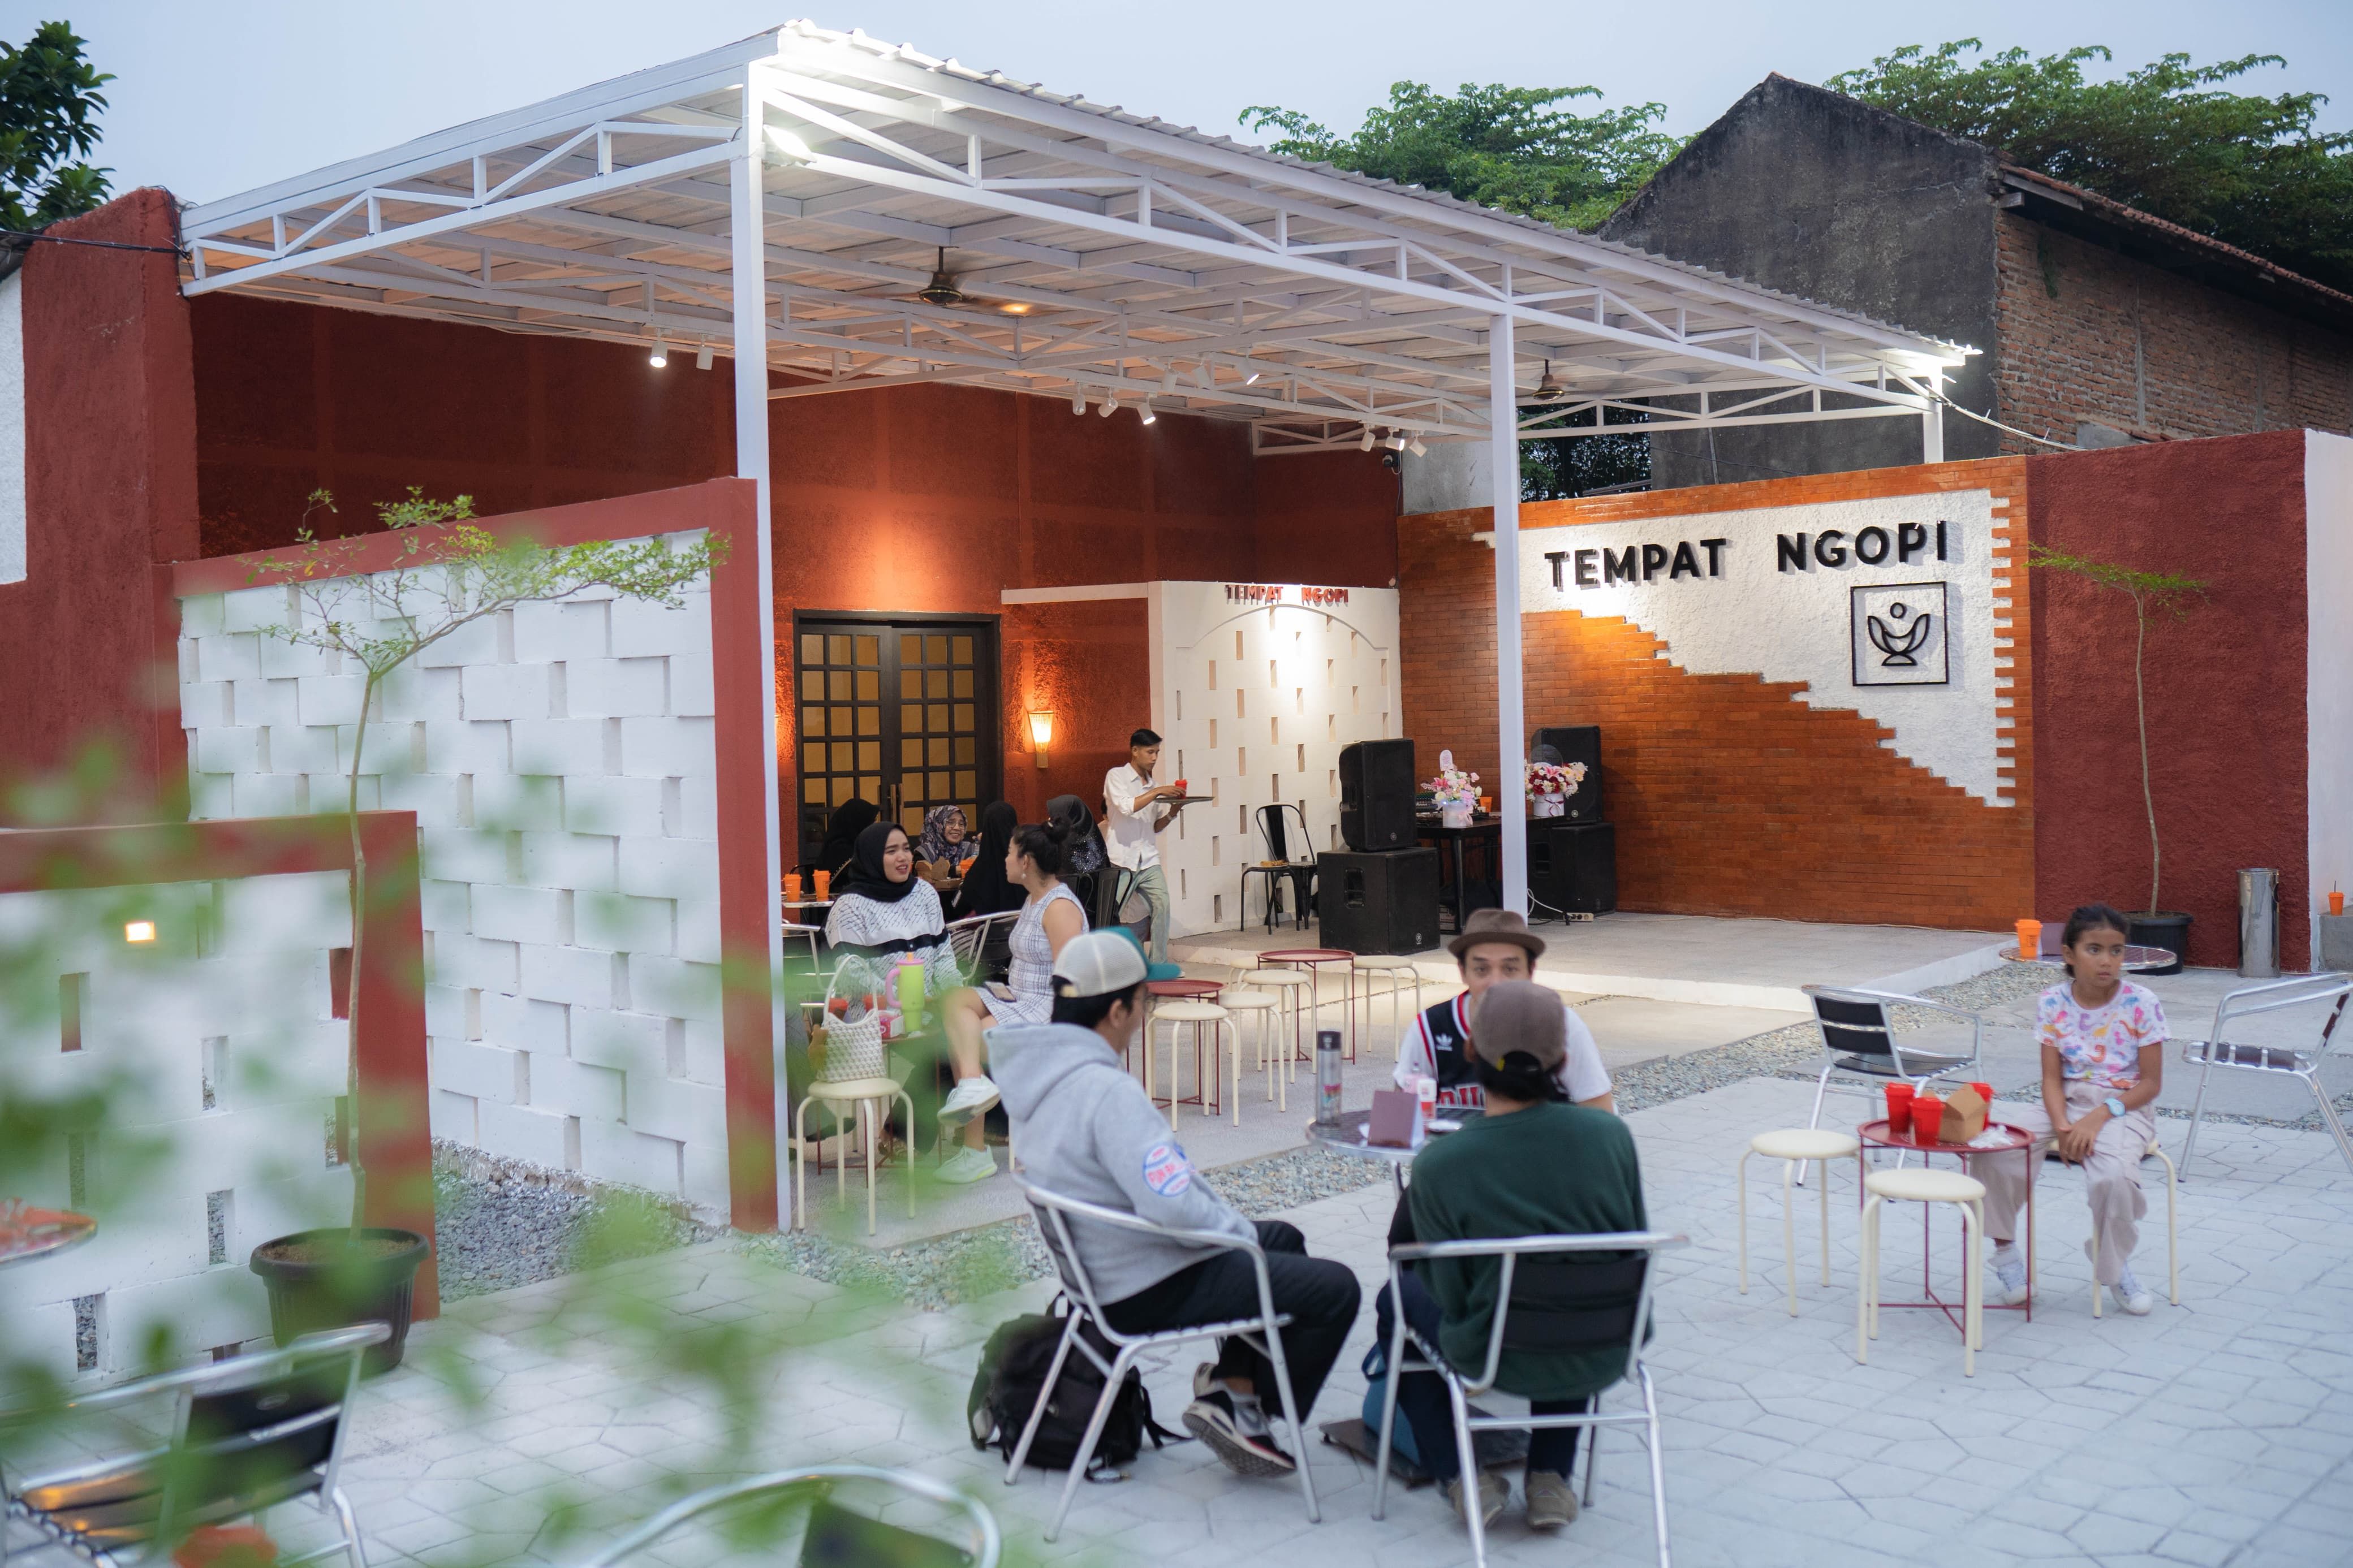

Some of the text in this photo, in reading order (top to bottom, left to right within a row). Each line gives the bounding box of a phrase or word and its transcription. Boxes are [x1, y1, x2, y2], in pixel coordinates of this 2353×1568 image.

[1544, 520, 1947, 589] TEMPAT NGOPI
[1225, 584, 1349, 603] TEMPAT NGOPI
